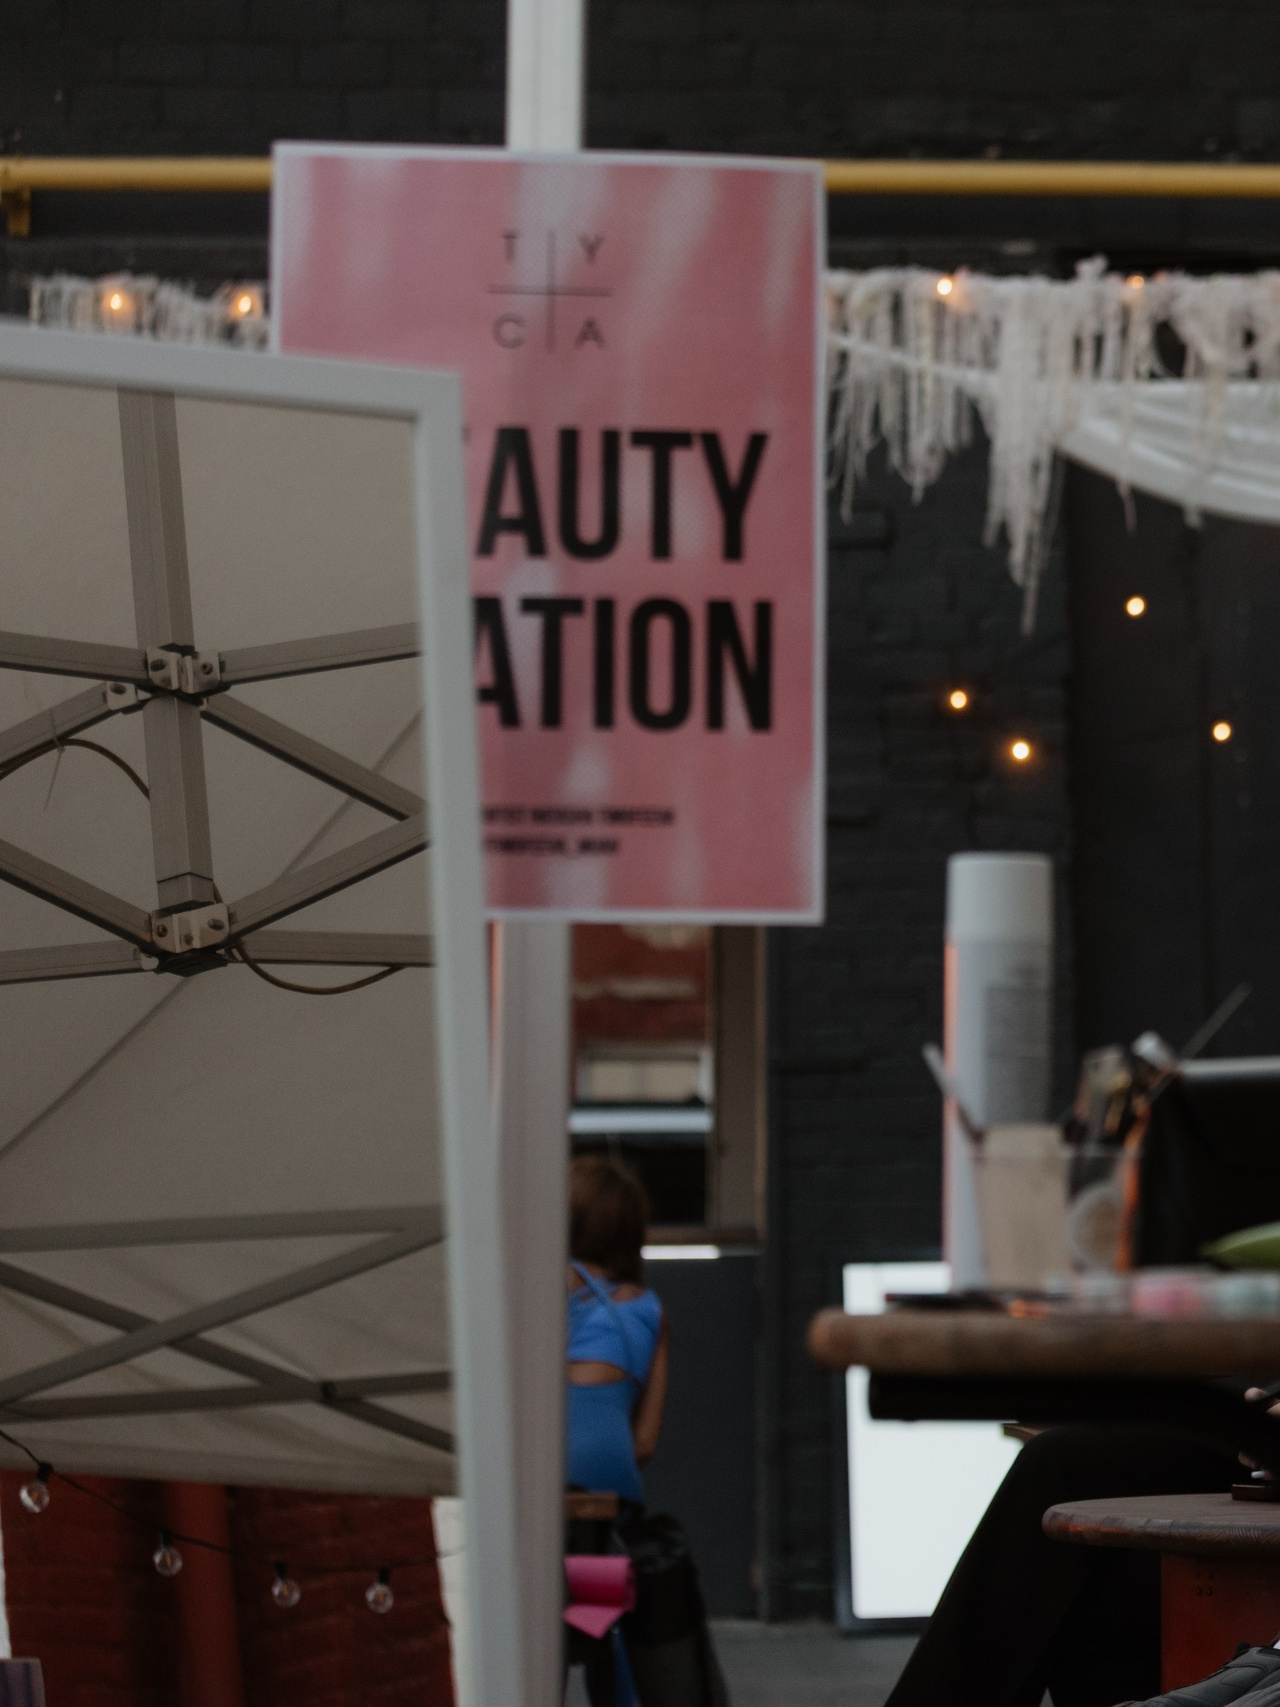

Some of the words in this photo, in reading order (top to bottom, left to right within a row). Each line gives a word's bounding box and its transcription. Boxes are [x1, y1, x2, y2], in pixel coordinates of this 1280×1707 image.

[501, 230, 519, 264] T
[576, 231, 605, 265] Y
[493, 312, 526, 350] C
[574, 316, 607, 350] A
[464, 425, 769, 562] AUTY
[473, 595, 772, 733] ATION
